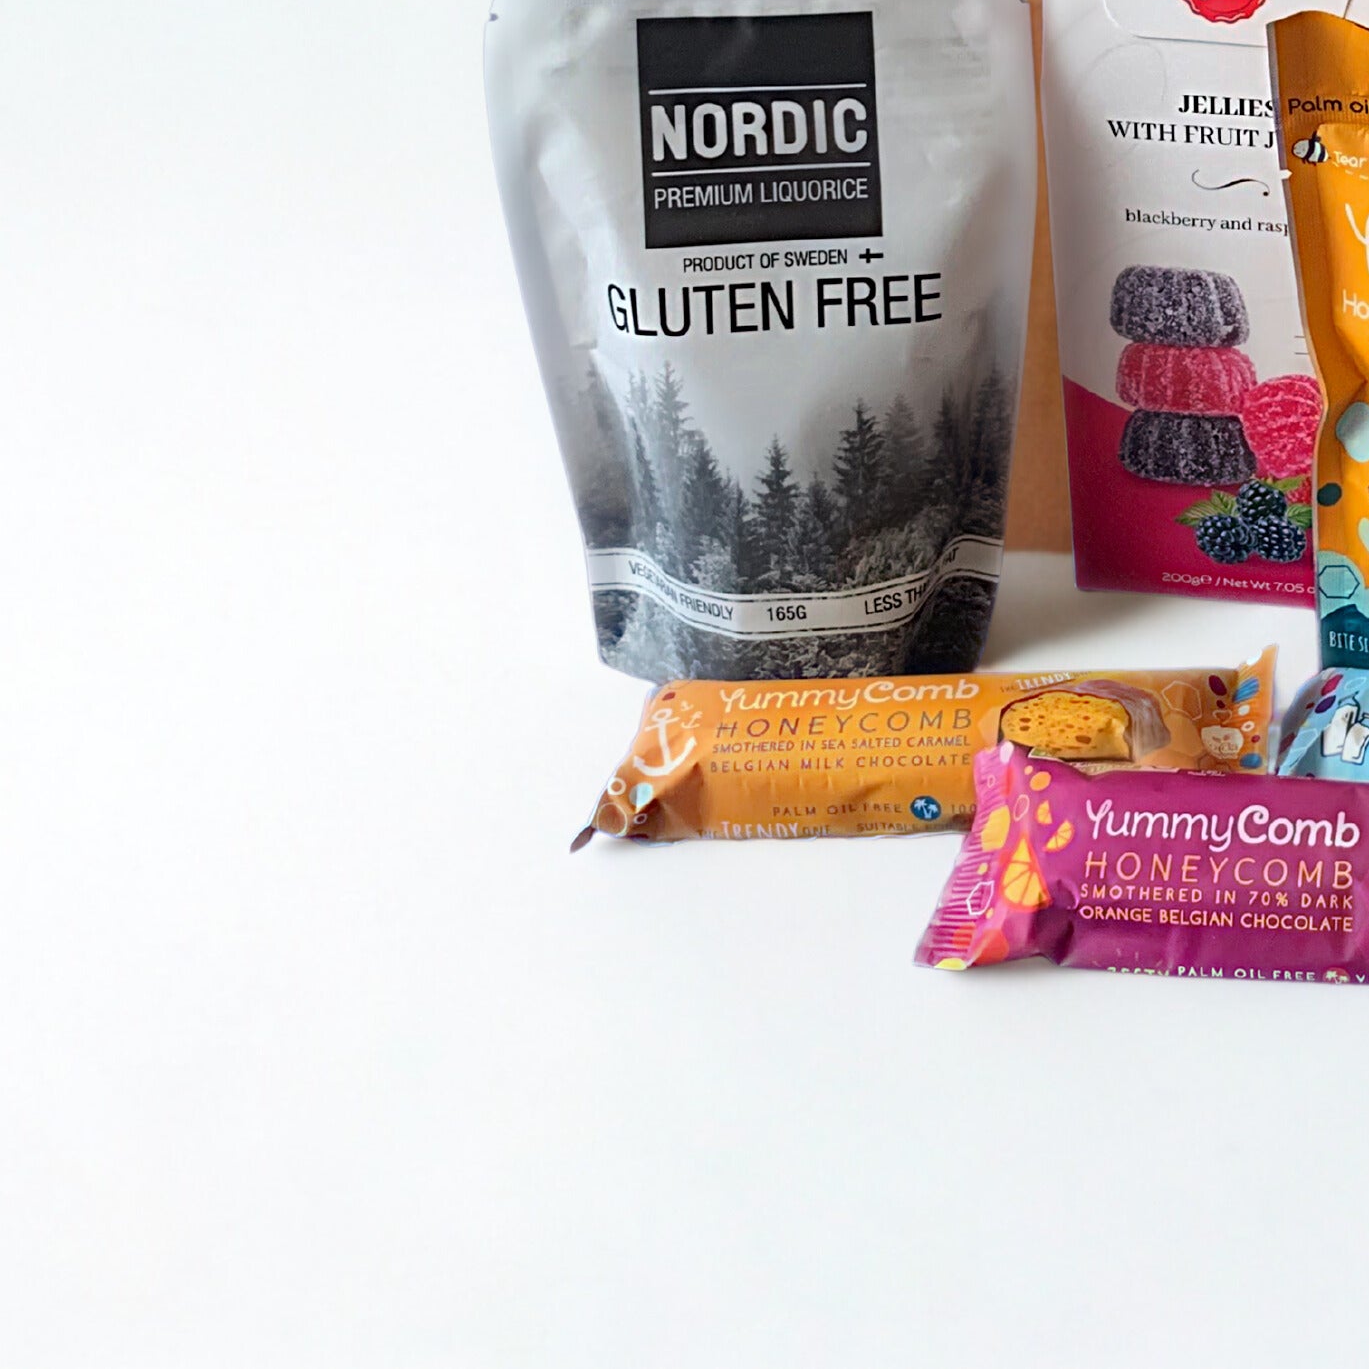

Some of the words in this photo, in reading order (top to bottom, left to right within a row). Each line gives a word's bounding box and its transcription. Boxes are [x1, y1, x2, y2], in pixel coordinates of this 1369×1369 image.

[1178, 94, 1274, 118] JELLIES
[1288, 96, 1343, 115] Palm
[650, 98, 868, 162] NORDIC
[1106, 119, 1176, 143] WITH
[1183, 124, 1259, 147] FRUIT
[1333, 150, 1368, 168] Tear
[654, 182, 753, 209] PREMIUM
[760, 177, 869, 203] LIQUORICE
[1125, 208, 1216, 231] blackberry
[1220, 217, 1251, 231] and
[683, 253, 755, 273] PRODUCT
[760, 252, 780, 269] OF
[784, 249, 848, 268] SWEDEN
[607, 280, 795, 337] GLUTEN
[816, 272, 943, 328] FREE
[1223, 578, 1249, 588] Net
[1250, 580, 1271, 592] Wt
[1274, 582, 1305, 594] 7.05
[679, 592, 734, 621] FRIENDLY
[767, 605, 807, 621] 165G
[864, 592, 903, 616] LESS
[1329, 631, 1355, 651] BITE
[719, 678, 980, 714] YummyComb
[716, 708, 972, 739] HONEYCOMB
[712, 739, 795, 754] SMOTHERED
[800, 739, 816, 751] IN
[821, 739, 846, 750] SEA
[852, 736, 901, 749] SALTED
[907, 735, 971, 747] CARAMEL
[710, 759, 790, 774] BELGIAN
[801, 757, 844, 770] MILK
[855, 753, 971, 769] CHOCOLATE
[772, 805, 817, 818] PALM
[827, 804, 856, 816] OIL
[950, 803, 975, 814] 100
[721, 820, 799, 840] TRENDY
[1086, 798, 1361, 852] YummyComb
[1084, 850, 1353, 890] HONEYCOMB
[1080, 883, 1203, 903] SMOTHERED
[1215, 890, 1236, 904] IN
[1248, 892, 1289, 907] 70%
[1300, 893, 1353, 910] DARK
[1079, 905, 1153, 922] ORANGE
[1159, 910, 1234, 928] BELGIAN
[1240, 913, 1353, 933] CHOCOLATE
[1177, 966, 1224, 978] PALM
[1234, 968, 1266, 979] OIL
[1273, 970, 1316, 981] FREE
